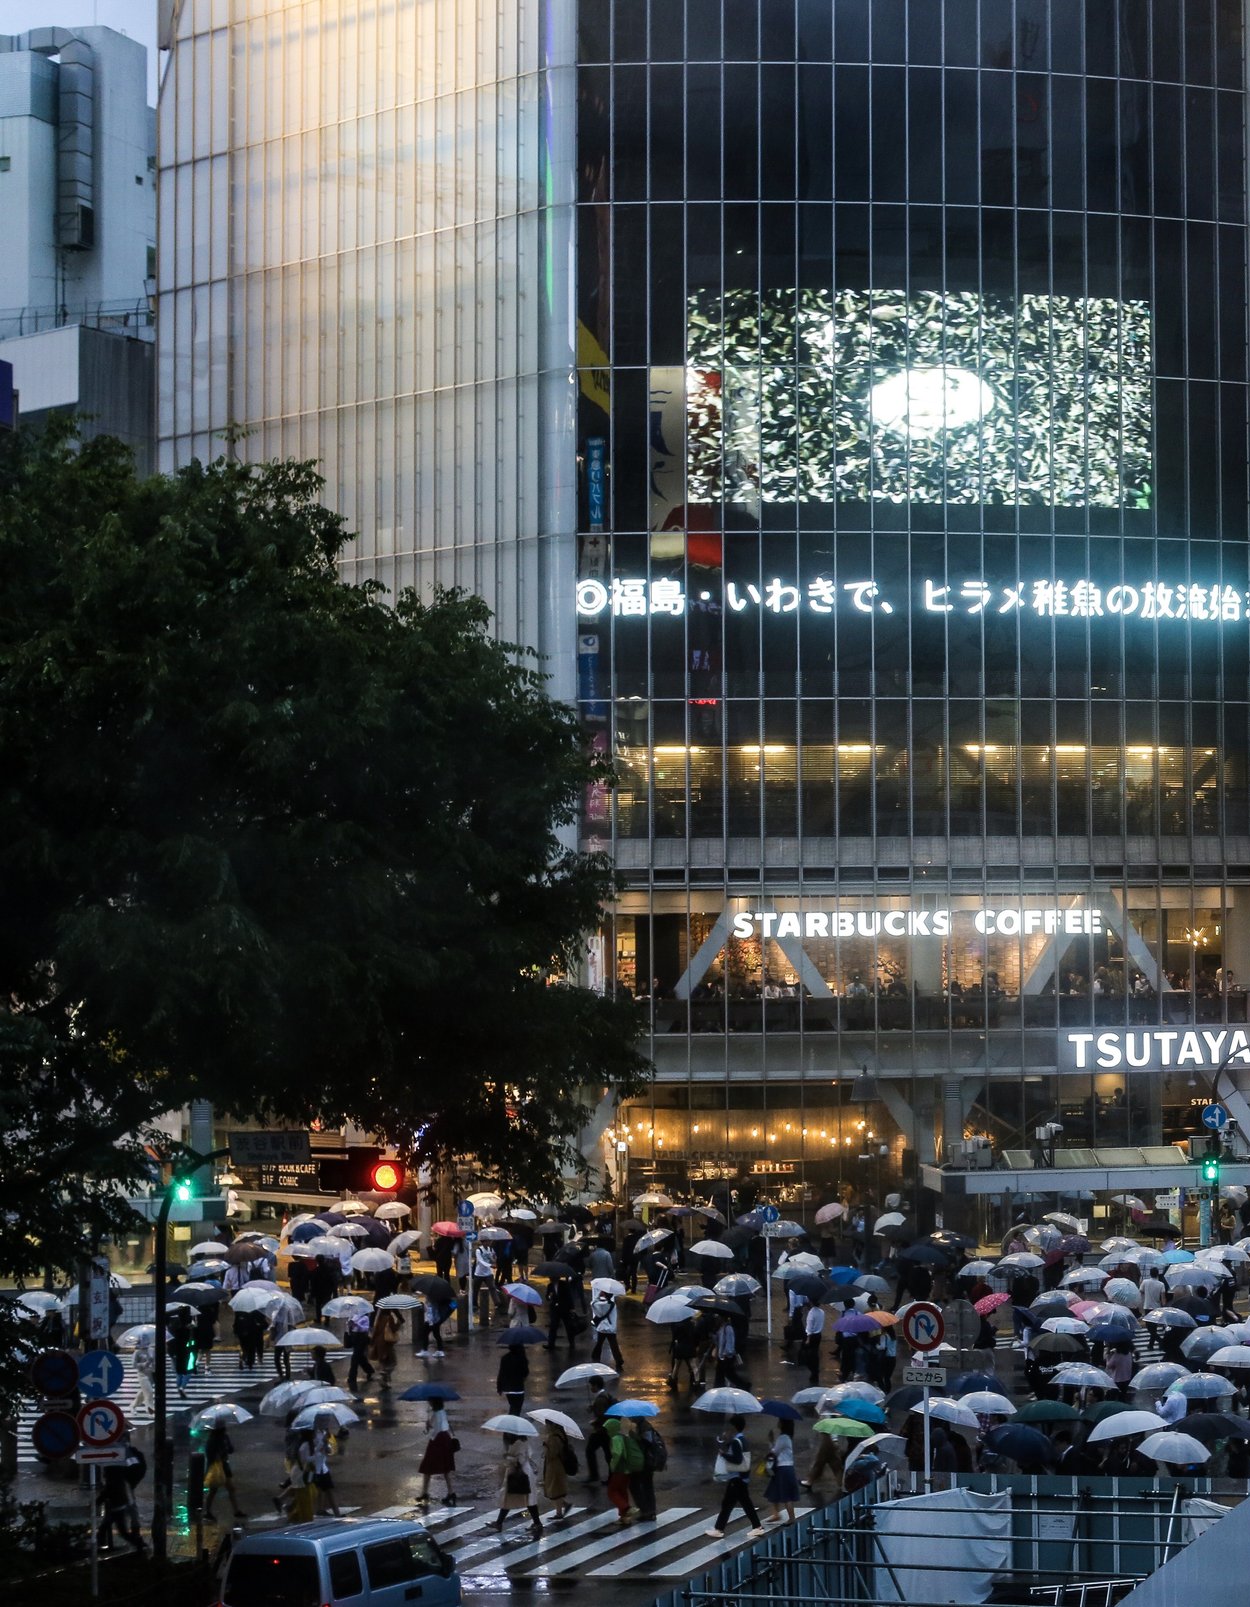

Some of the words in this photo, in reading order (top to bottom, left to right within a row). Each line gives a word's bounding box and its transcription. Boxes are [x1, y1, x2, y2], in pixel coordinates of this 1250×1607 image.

[733, 909, 952, 939] STARBUCKS
[974, 908, 1103, 935] COFFEE
[235, 1135, 304, 1151] 渋谷駅前
[278, 1163, 316, 1174] BOOK&CAFE
[262, 1174, 274, 1185] B1F
[278, 1175, 299, 1187] COMIC
[905, 1371, 944, 1383] ここから
